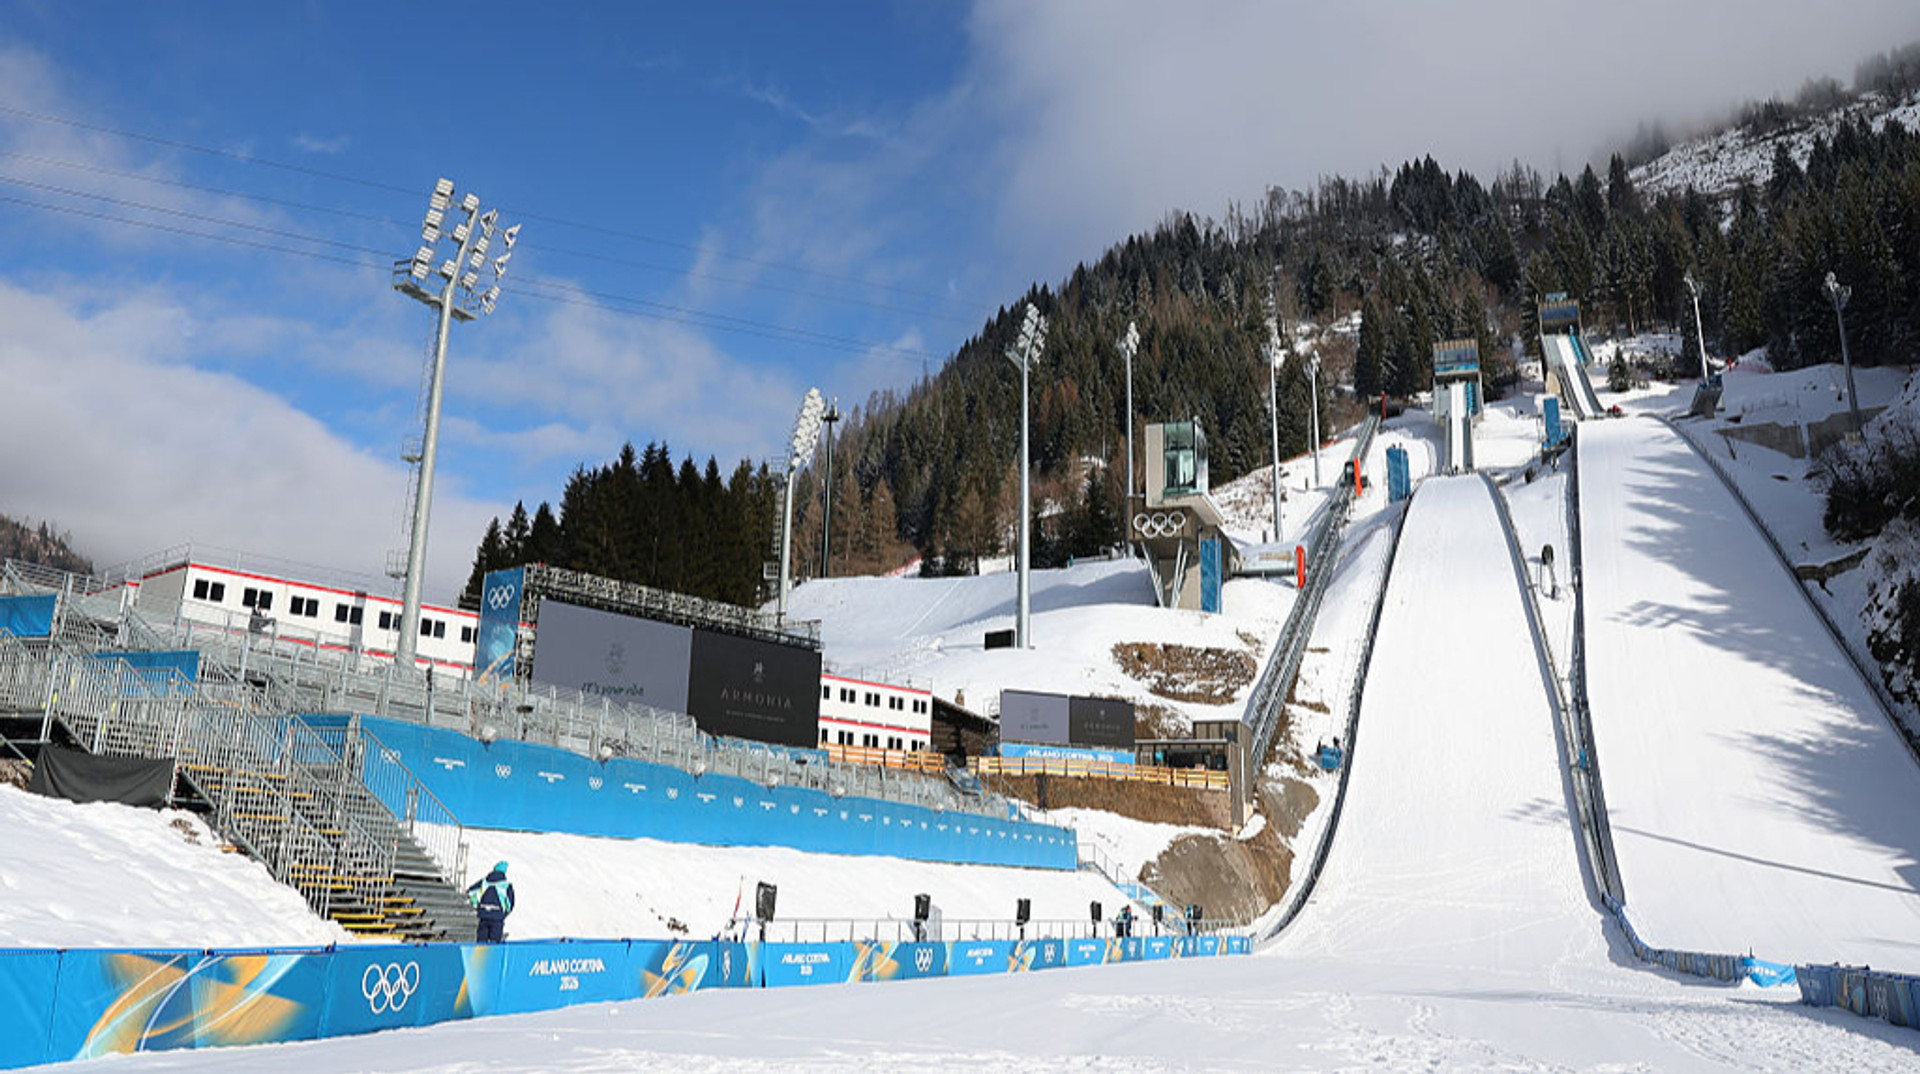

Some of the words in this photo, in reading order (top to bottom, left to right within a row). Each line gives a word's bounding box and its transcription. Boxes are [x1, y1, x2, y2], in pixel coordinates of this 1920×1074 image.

[720, 687, 791, 710] ARMONIA
[528, 959, 569, 976] MILANO
[570, 958, 605, 974] CORTINA
[558, 975, 580, 991] 2026
